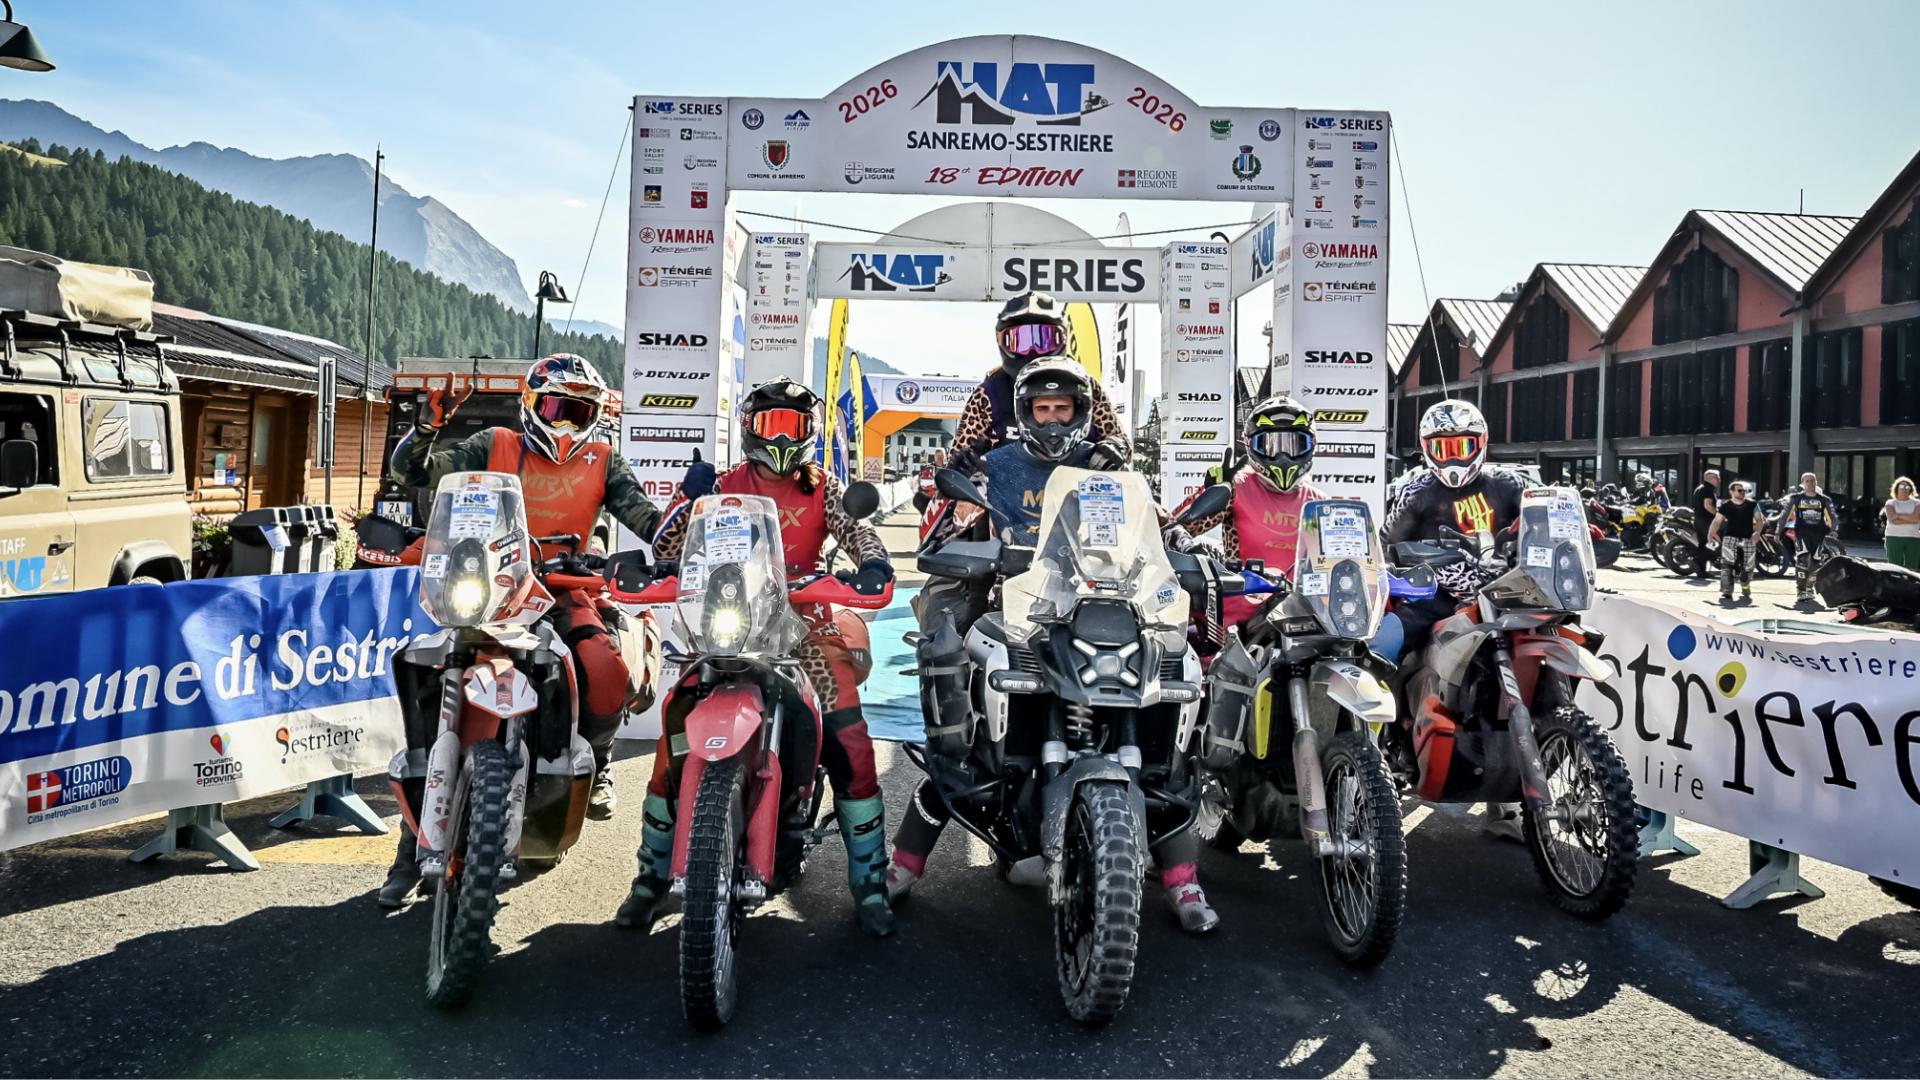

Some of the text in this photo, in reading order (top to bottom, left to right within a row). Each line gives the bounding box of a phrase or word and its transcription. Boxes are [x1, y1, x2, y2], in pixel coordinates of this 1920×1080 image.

[936, 61, 1095, 126] HAT
[838, 78, 898, 124] 2026
[679, 103, 723, 115] SERIES
[1126, 87, 1187, 133] 2026
[1340, 119, 1383, 131] SERIES
[906, 130, 1114, 153] SANREMO-SESTRIERE
[864, 173, 896, 181] LIGURIA
[977, 166, 1084, 187] EDITION
[1137, 170, 1177, 180] REGIONE
[1137, 179, 1178, 189] PIEMONTE
[656, 228, 715, 244] YAMAHA
[777, 237, 805, 245] SERIES
[1200, 246, 1228, 255] SERIES
[1320, 243, 1378, 259] YAMAHA
[660, 265, 713, 276] TÉNÉRÉ
[850, 253, 1146, 293] HAT SERIES
[660, 280, 699, 288] SPIRIT
[1325, 280, 1377, 291] TÉNÉRÉ
[1325, 294, 1363, 303] SPIRIT
[762, 314, 799, 324] YAMAHA
[1187, 324, 1224, 335] YAMAHA
[638, 333, 708, 347] SHAD
[1304, 350, 1373, 364] SHAD
[644, 370, 711, 380] DUNLOP
[1178, 393, 1222, 402] SHAD
[1313, 387, 1379, 396] DUNLOP
[631, 428, 704, 438] ENDURISTAN
[640, 458, 693, 468] MYTEC
[1312, 474, 1376, 484] MYTECH
[389, 502, 401, 514] ZA
[0, 536, 27, 555] TAFF
[357, 548, 402, 563] ACERBIS
[0, 616, 436, 737] omune di Sestri
[276, 726, 364, 764] Sestriere
[64, 758, 120, 786] TORINO
[193, 761, 243, 778] Torino
[1644, 755, 1704, 800] life
[62, 777, 120, 803] METROPOLI
[44, 804, 89, 819] metropolitana
[90, 801, 97, 810] di
[98, 796, 120, 808] Torino
